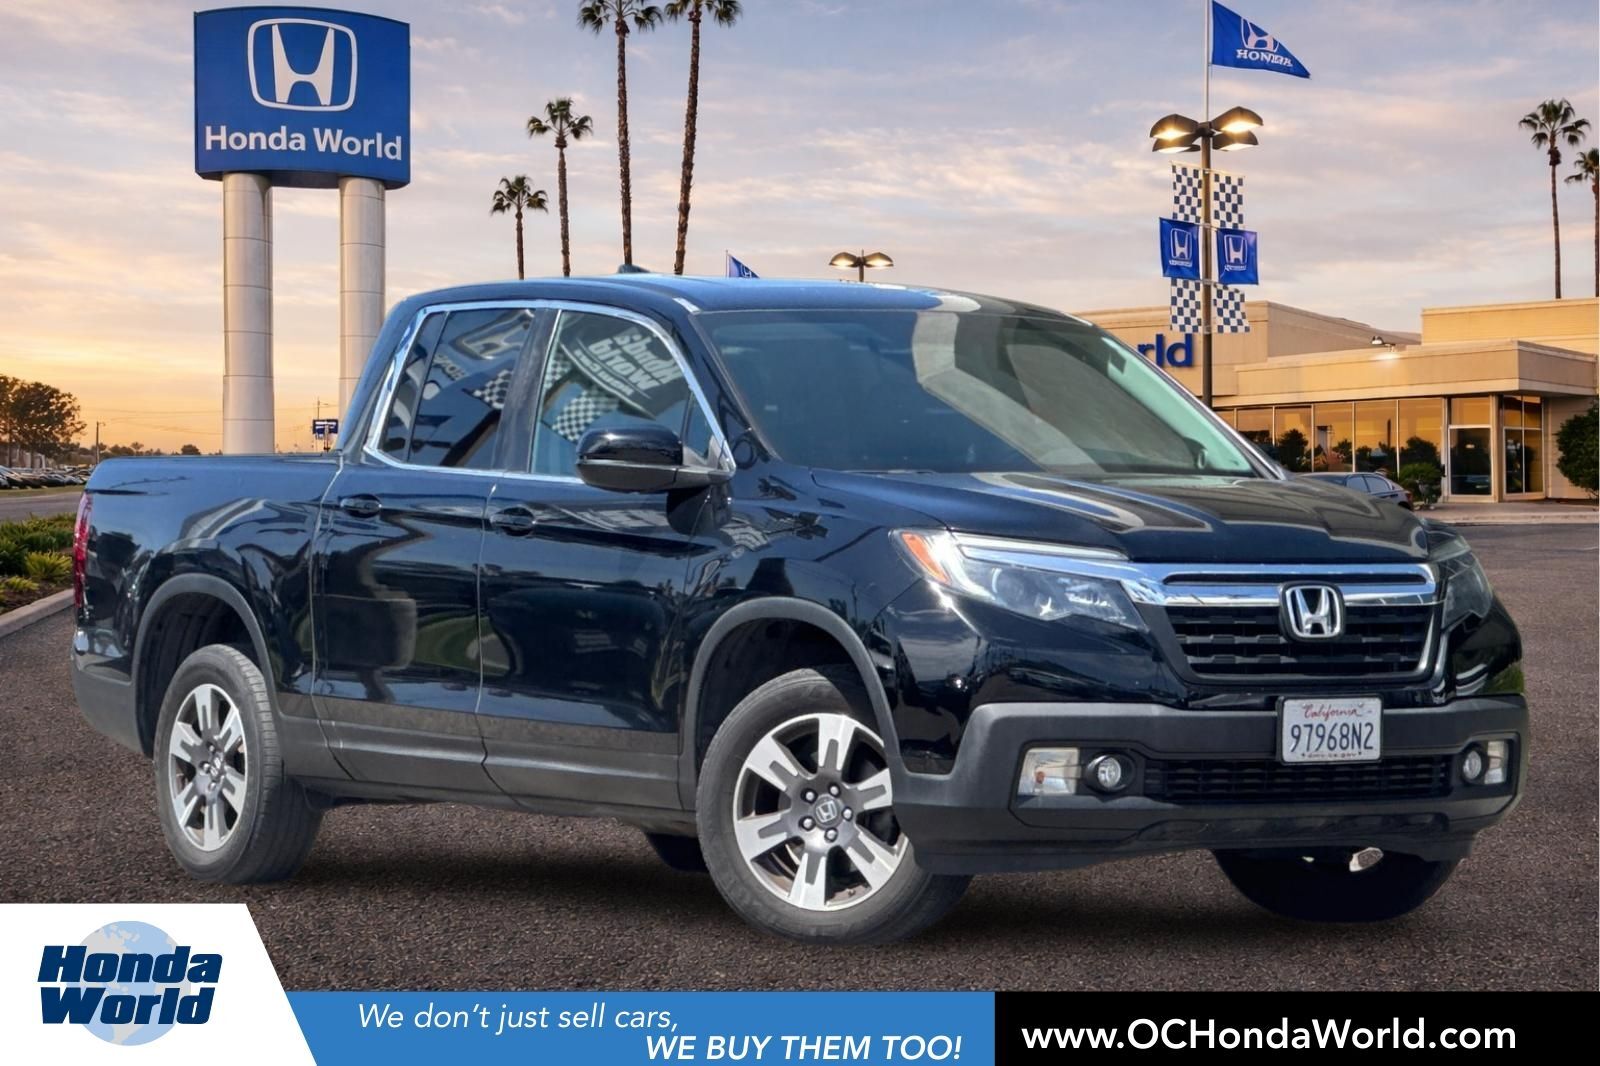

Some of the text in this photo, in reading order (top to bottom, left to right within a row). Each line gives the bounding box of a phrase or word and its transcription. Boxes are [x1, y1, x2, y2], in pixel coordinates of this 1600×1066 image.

[1236, 49, 1293, 67] HONDA
[205, 125, 402, 160] Honda World
[1302, 703, 1363, 721] California
[1290, 722, 1374, 752] 97968N2
